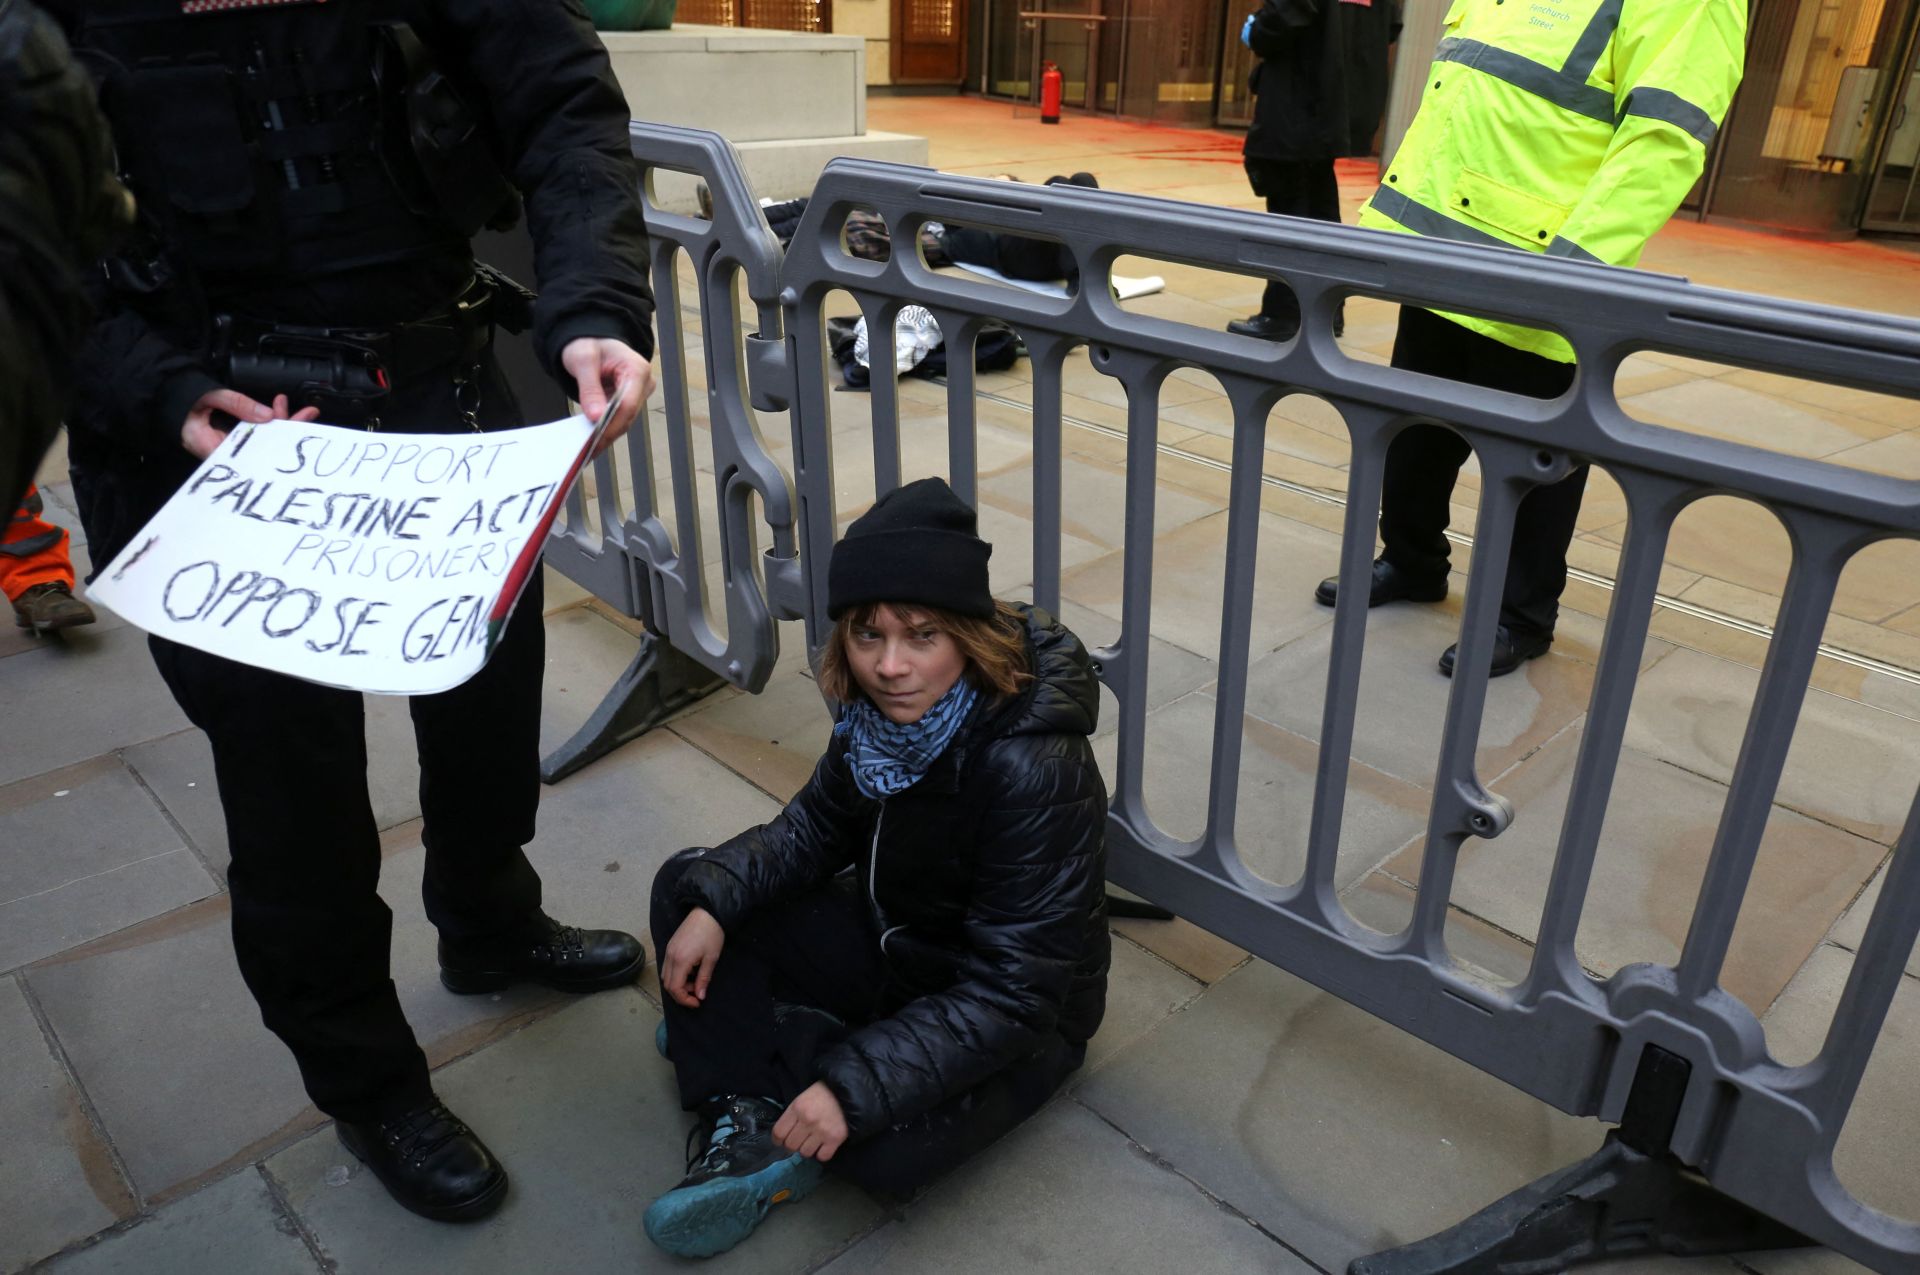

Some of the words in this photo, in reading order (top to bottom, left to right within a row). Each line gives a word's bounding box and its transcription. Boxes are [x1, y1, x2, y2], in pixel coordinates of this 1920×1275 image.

[1528, 16, 1554, 30] Street
[276, 435, 519, 484] SUPPORT
[188, 464, 441, 540] PALESTINE
[282, 536, 520, 582] PRISONERS
[163, 560, 391, 656] OPPOSE
